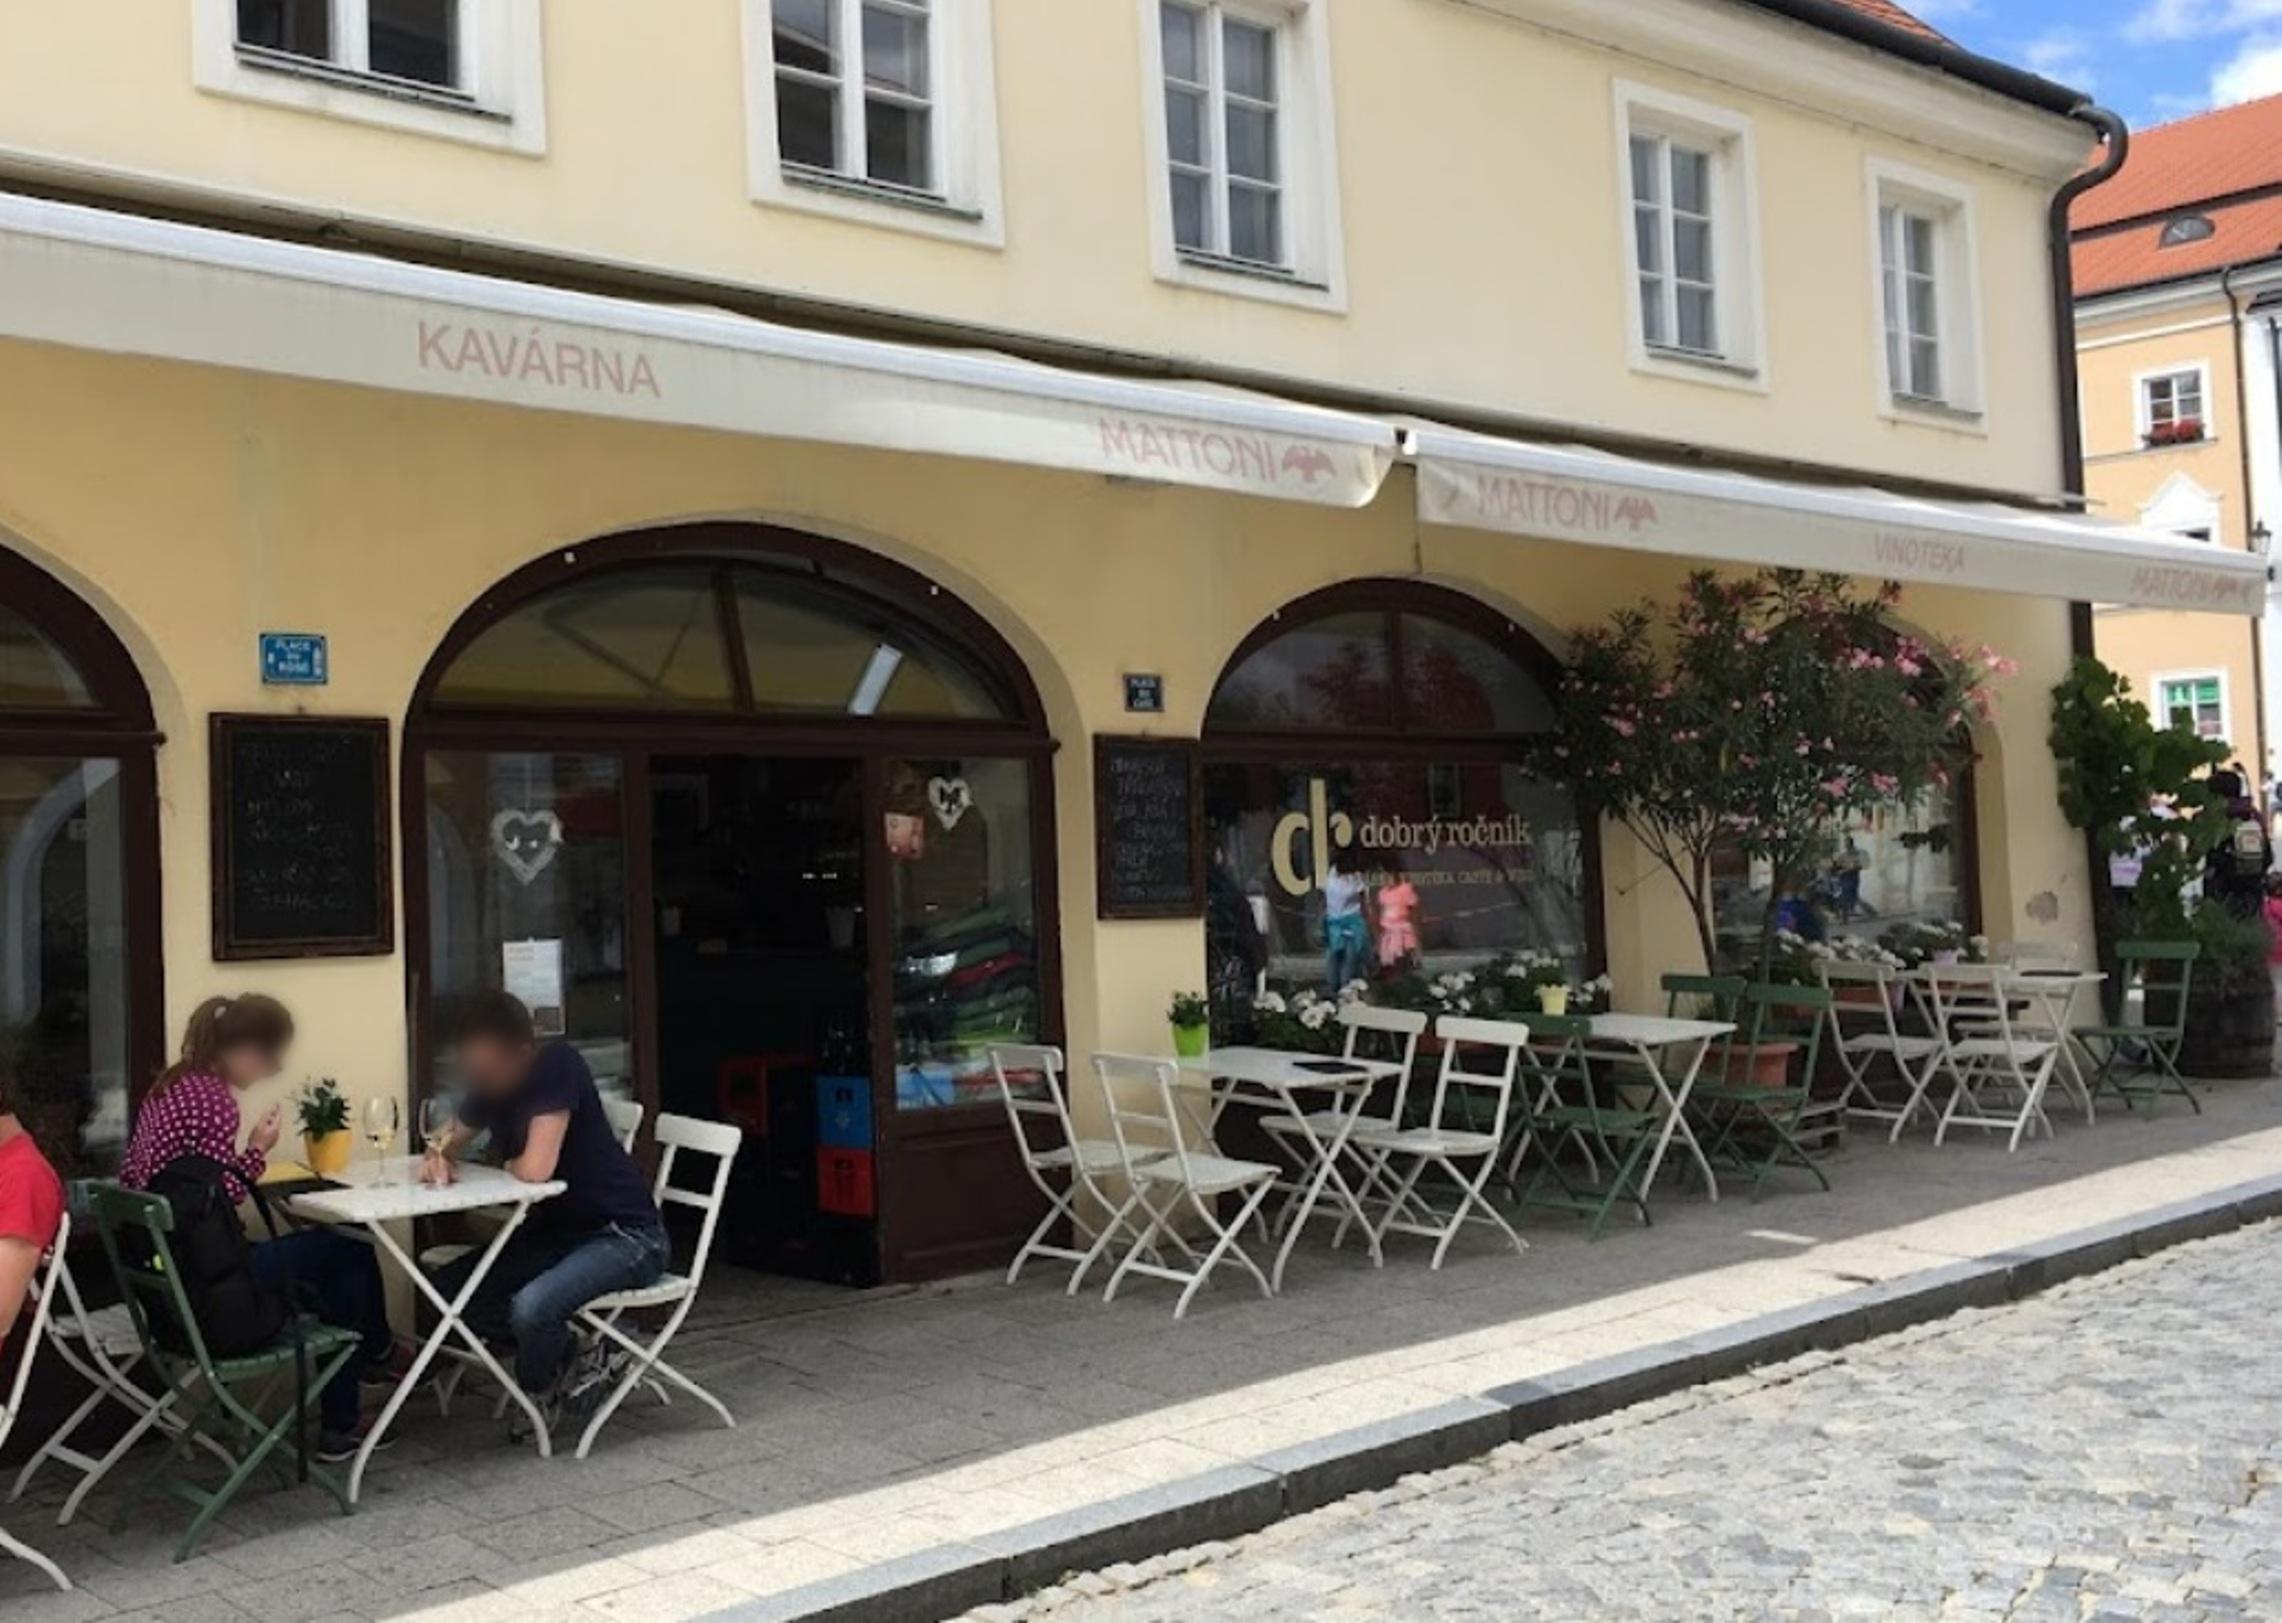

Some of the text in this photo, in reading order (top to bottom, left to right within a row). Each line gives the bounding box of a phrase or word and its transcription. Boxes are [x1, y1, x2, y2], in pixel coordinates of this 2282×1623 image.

[418, 319, 662, 400] KAVÁRNA
[1099, 416, 1276, 483] MATTONI
[1477, 473, 1610, 531] MATTONI
[2131, 566, 2211, 600] MATTONI
[1359, 813, 1533, 856] dobrý ročník
